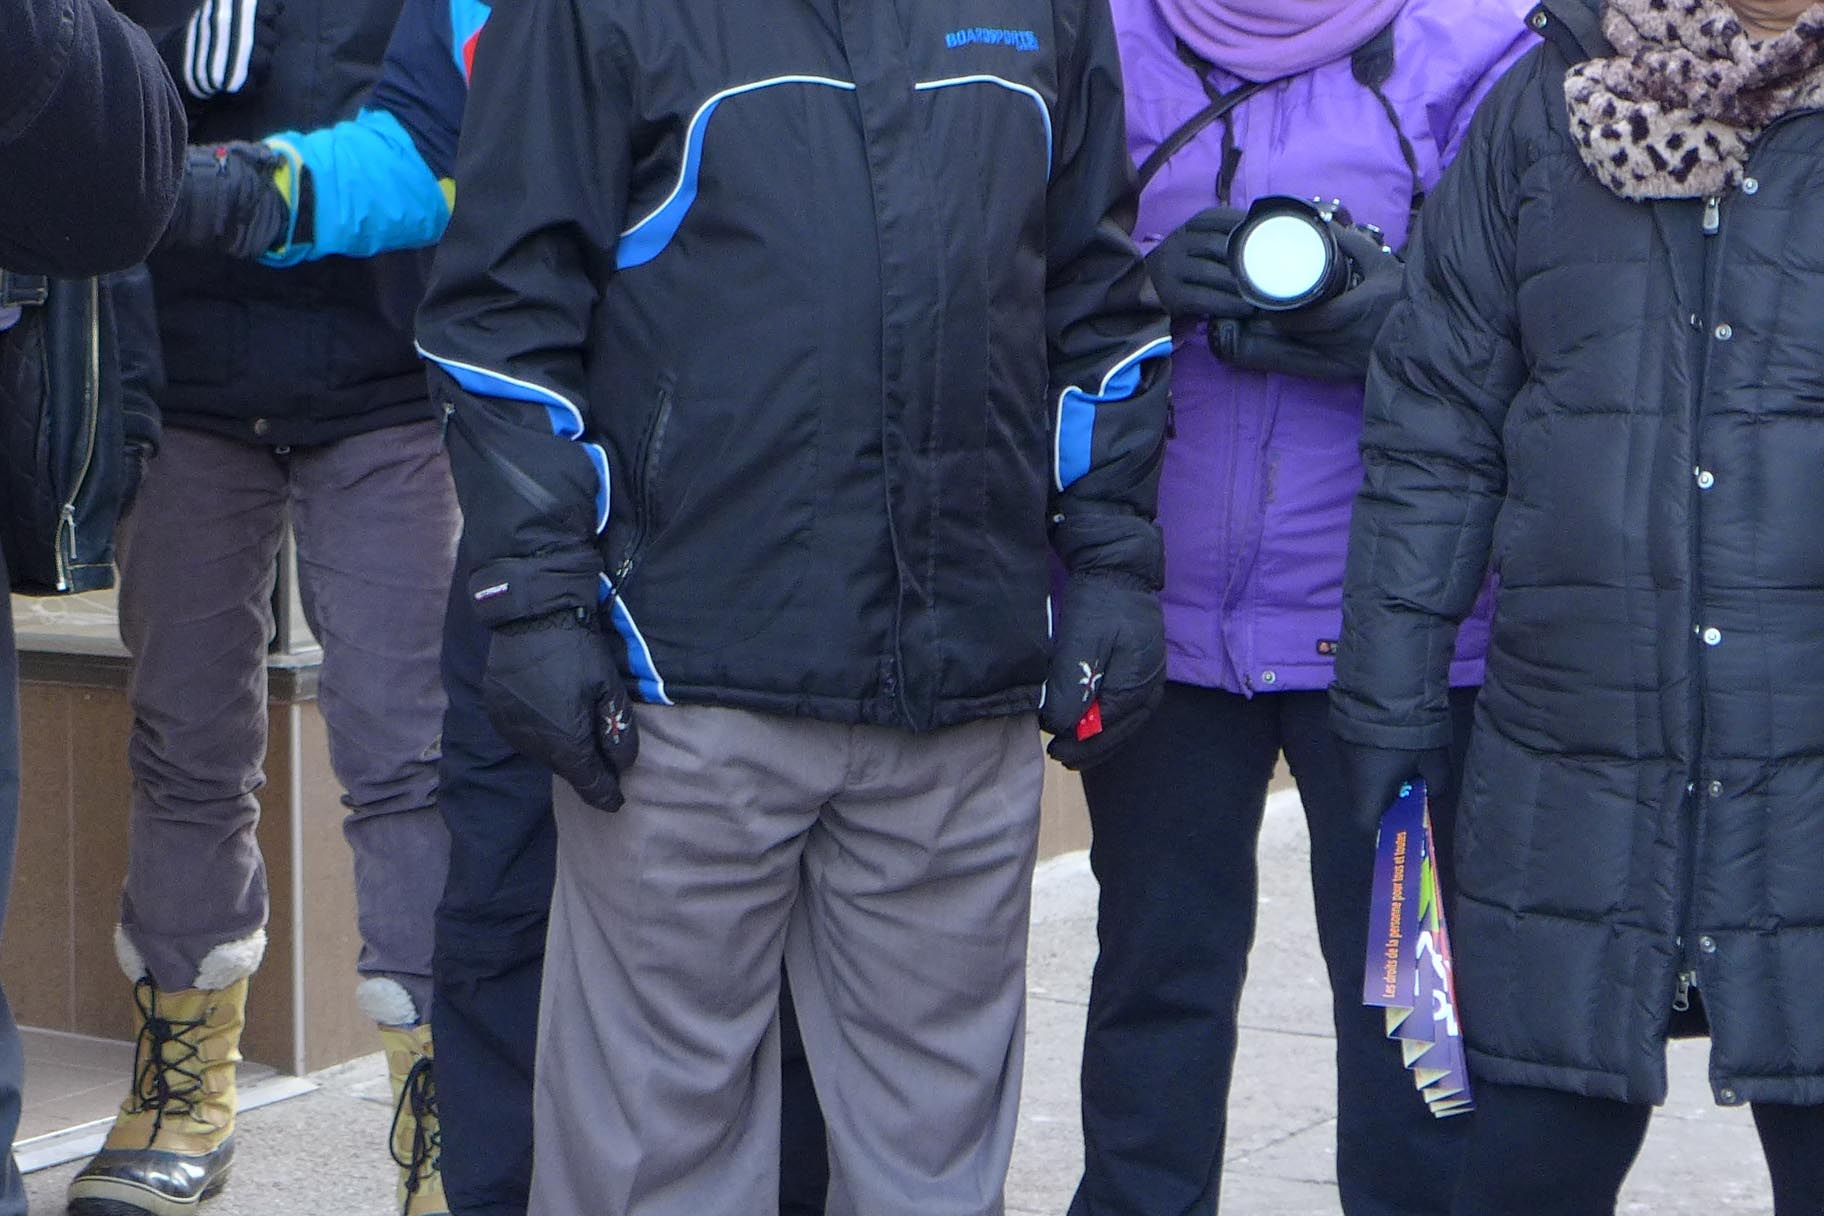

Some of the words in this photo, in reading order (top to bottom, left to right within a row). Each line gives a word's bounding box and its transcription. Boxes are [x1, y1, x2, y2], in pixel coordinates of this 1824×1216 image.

[1392, 865, 1405, 881] tous
[1392, 883, 1405, 901] pour
[1389, 902, 1402, 937] personne
[1386, 938, 1399, 947] la
[1386, 947, 1398, 959] de
[1384, 960, 1397, 983] droits
[1383, 984, 1395, 998] Les
